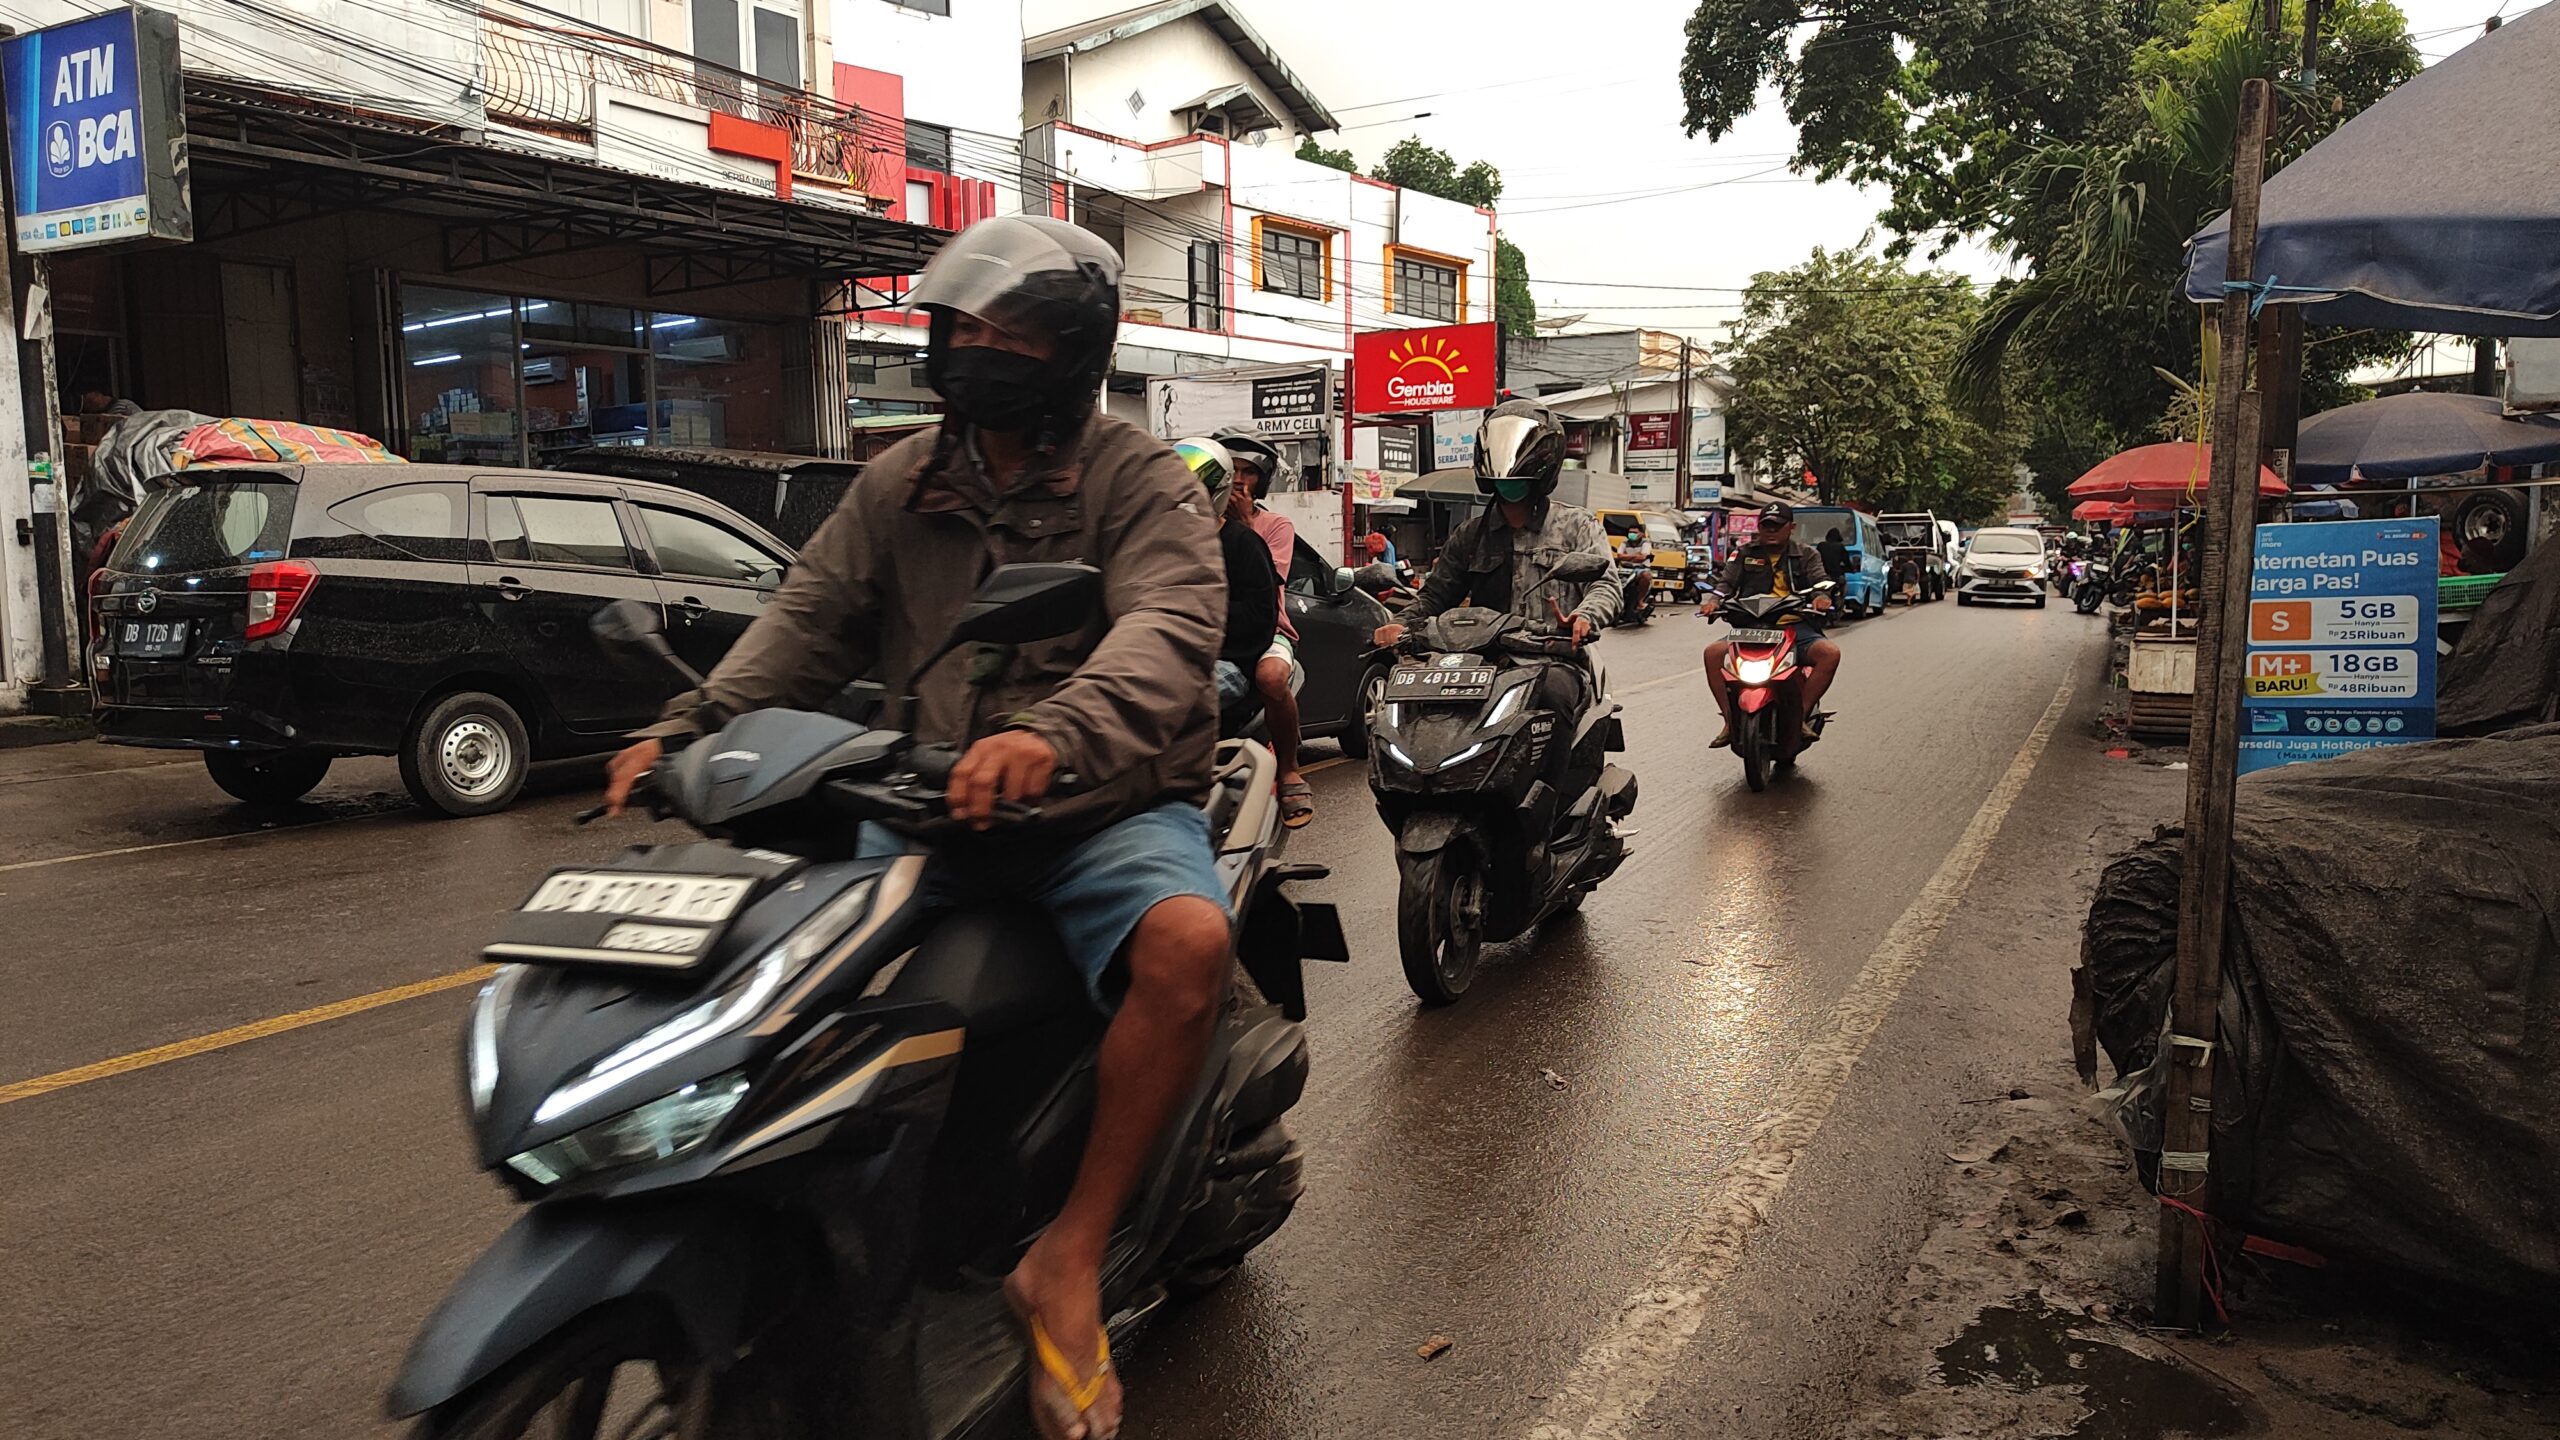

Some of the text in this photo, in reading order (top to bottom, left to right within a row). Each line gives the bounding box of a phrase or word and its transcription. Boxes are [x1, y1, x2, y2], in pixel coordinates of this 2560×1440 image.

[53, 43, 115, 107] ATM
[77, 108, 136, 168] BCA
[650, 162, 680, 176] LIGHTS
[1387, 376, 1454, 398] Gembira
[1404, 395, 1455, 406] HOUSEWARE
[1257, 419, 1290, 432] ARMY
[1451, 446, 1469, 454] TOKO
[1437, 454, 1458, 464] SERBA
[2362, 550, 2419, 567] Puas
[2313, 573, 2360, 590] Pas!
[2271, 611, 2290, 632] S
[124, 622, 185, 643] DB 1726 RC
[2259, 655, 2302, 676] M+
[1397, 671, 1490, 685] DB 4813 TB
[2353, 673, 2380, 681] Hanya
[2255, 678, 2308, 693] BARU!
[2239, 740, 2283, 750] ersedia
[2287, 740, 2318, 753] Juga
[2321, 740, 2370, 750] HotRod
